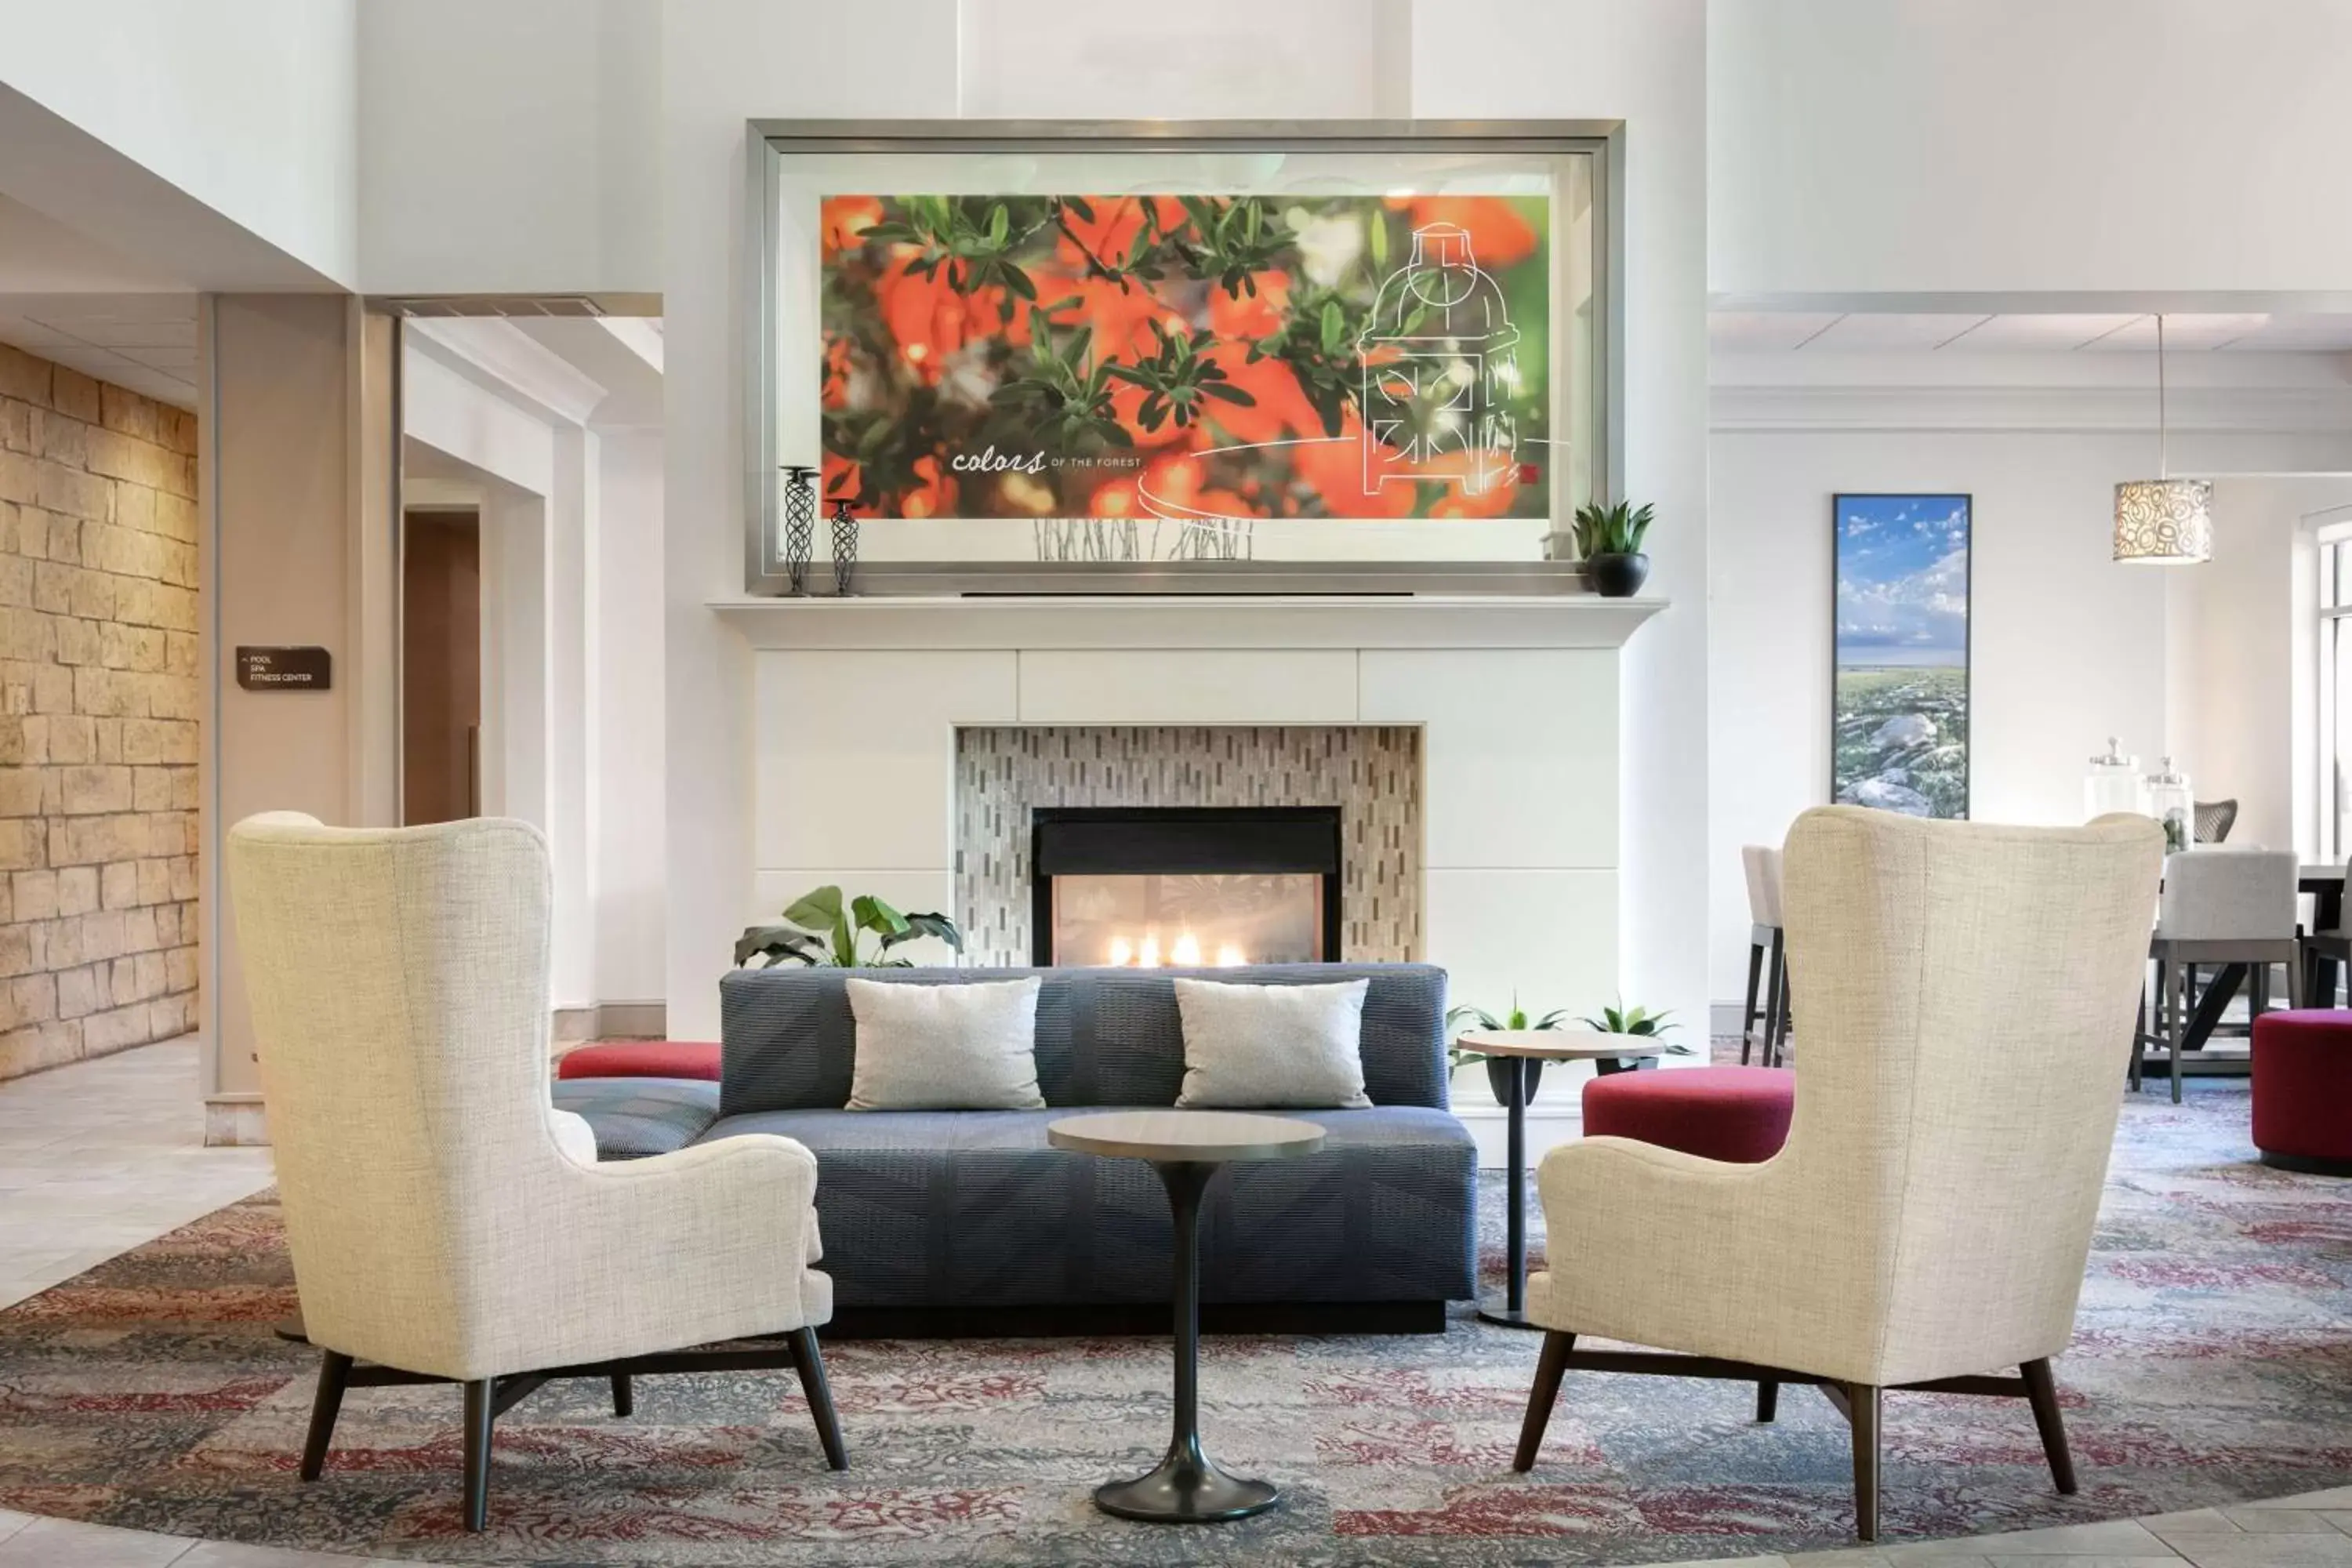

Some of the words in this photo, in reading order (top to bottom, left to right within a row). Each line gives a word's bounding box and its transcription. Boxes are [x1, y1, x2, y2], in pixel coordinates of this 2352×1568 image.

[951, 445, 1047, 474] colors
[1051, 457, 1065, 467] OF
[1071, 457, 1093, 467] THE
[1098, 457, 1142, 467] FOREST
